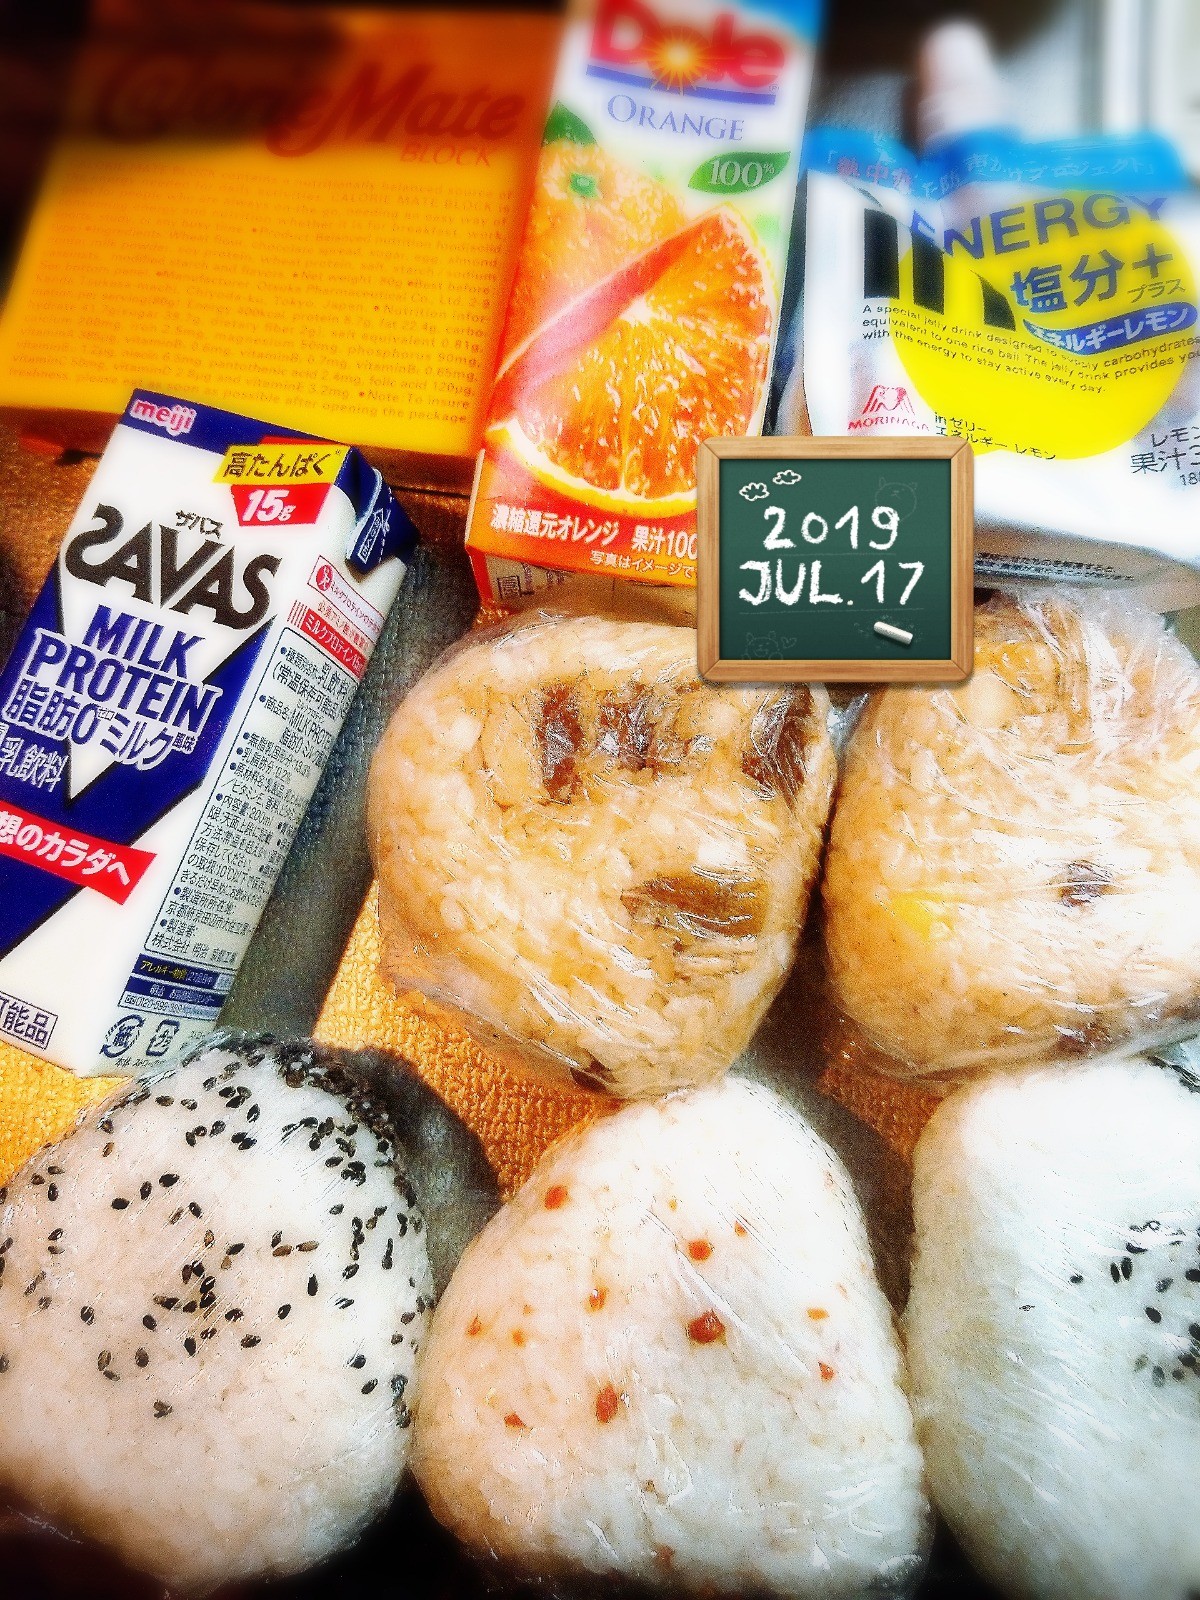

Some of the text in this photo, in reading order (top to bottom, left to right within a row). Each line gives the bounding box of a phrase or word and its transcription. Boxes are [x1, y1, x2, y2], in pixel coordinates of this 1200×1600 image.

[590, 0, 785, 87] Dole
[711, 160, 775, 187] 100%
[1128, 278, 1186, 304] プラス
[862, 305, 872, 313] A
[951, 325, 982, 338] drink
[862, 328, 890, 340] with
[895, 329, 914, 343] the
[917, 340, 957, 359] energy
[1114, 354, 1175, 380] provides
[132, 400, 193, 432] meiji
[223, 452, 331, 478] 高たんぱく
[1180, 471, 1200, 486] 18
[174, 510, 224, 538] ザバス
[490, 504, 620, 546] 濃縮還元オレンジ
[64, 502, 283, 630] SAVAS
[82, 604, 206, 678] MILK
[26, 632, 219, 733] PROTEIN
